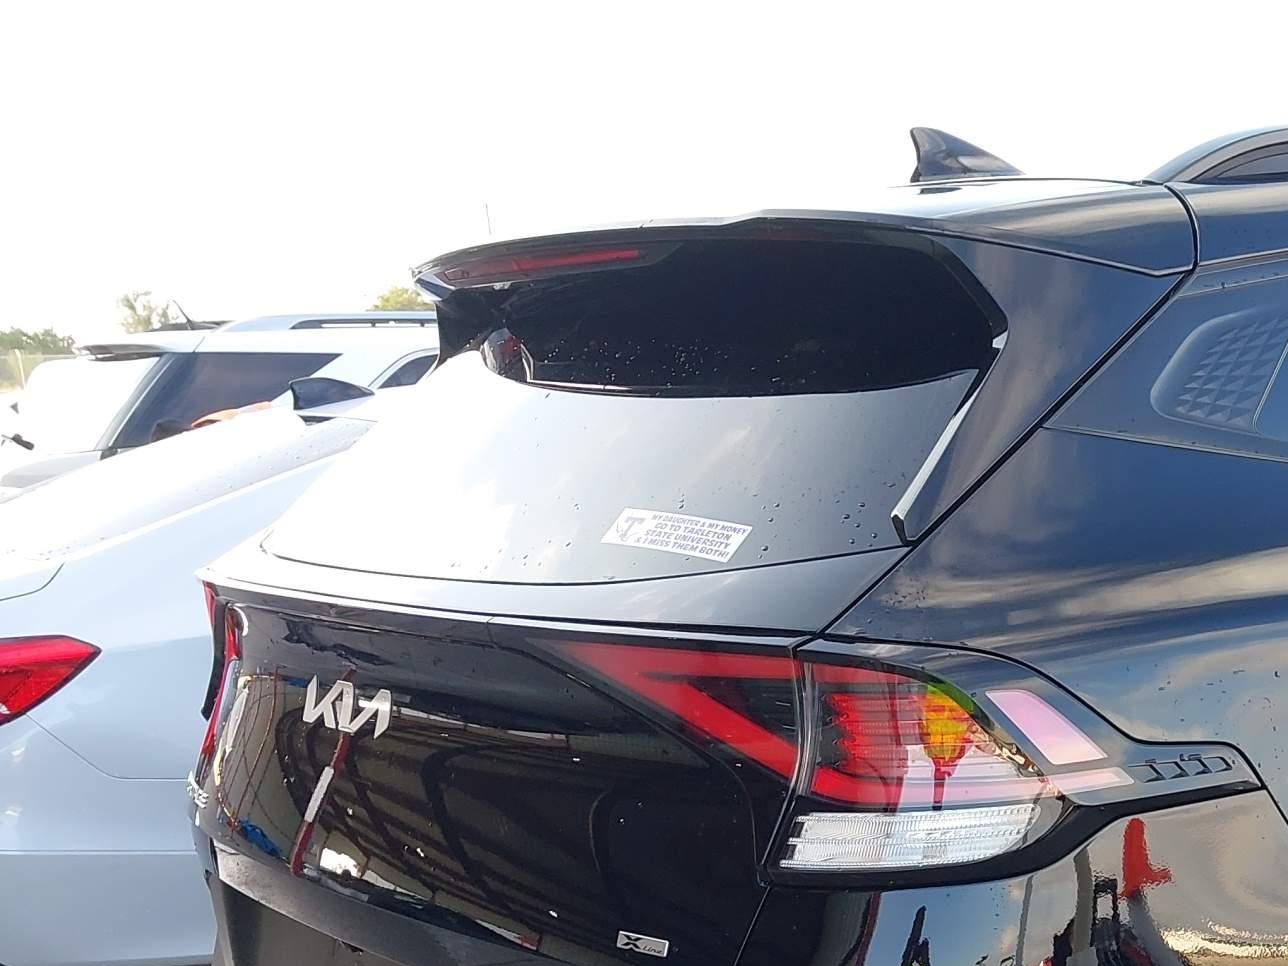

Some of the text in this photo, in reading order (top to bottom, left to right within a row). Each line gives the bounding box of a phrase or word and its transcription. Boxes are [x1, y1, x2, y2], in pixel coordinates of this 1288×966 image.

[663, 515, 699, 527] DAUGHTER
[707, 522, 720, 530] MY
[721, 524, 748, 536] MONEY
[669, 524, 682, 532] TO
[683, 525, 733, 541] TARLETON
[645, 529, 732, 550] STATE UNIVERSITY
[647, 538, 671, 548] MISS
[672, 541, 699, 552] THEM
[699, 545, 730, 559] BOTH!
[302, 674, 393, 740] KIA
